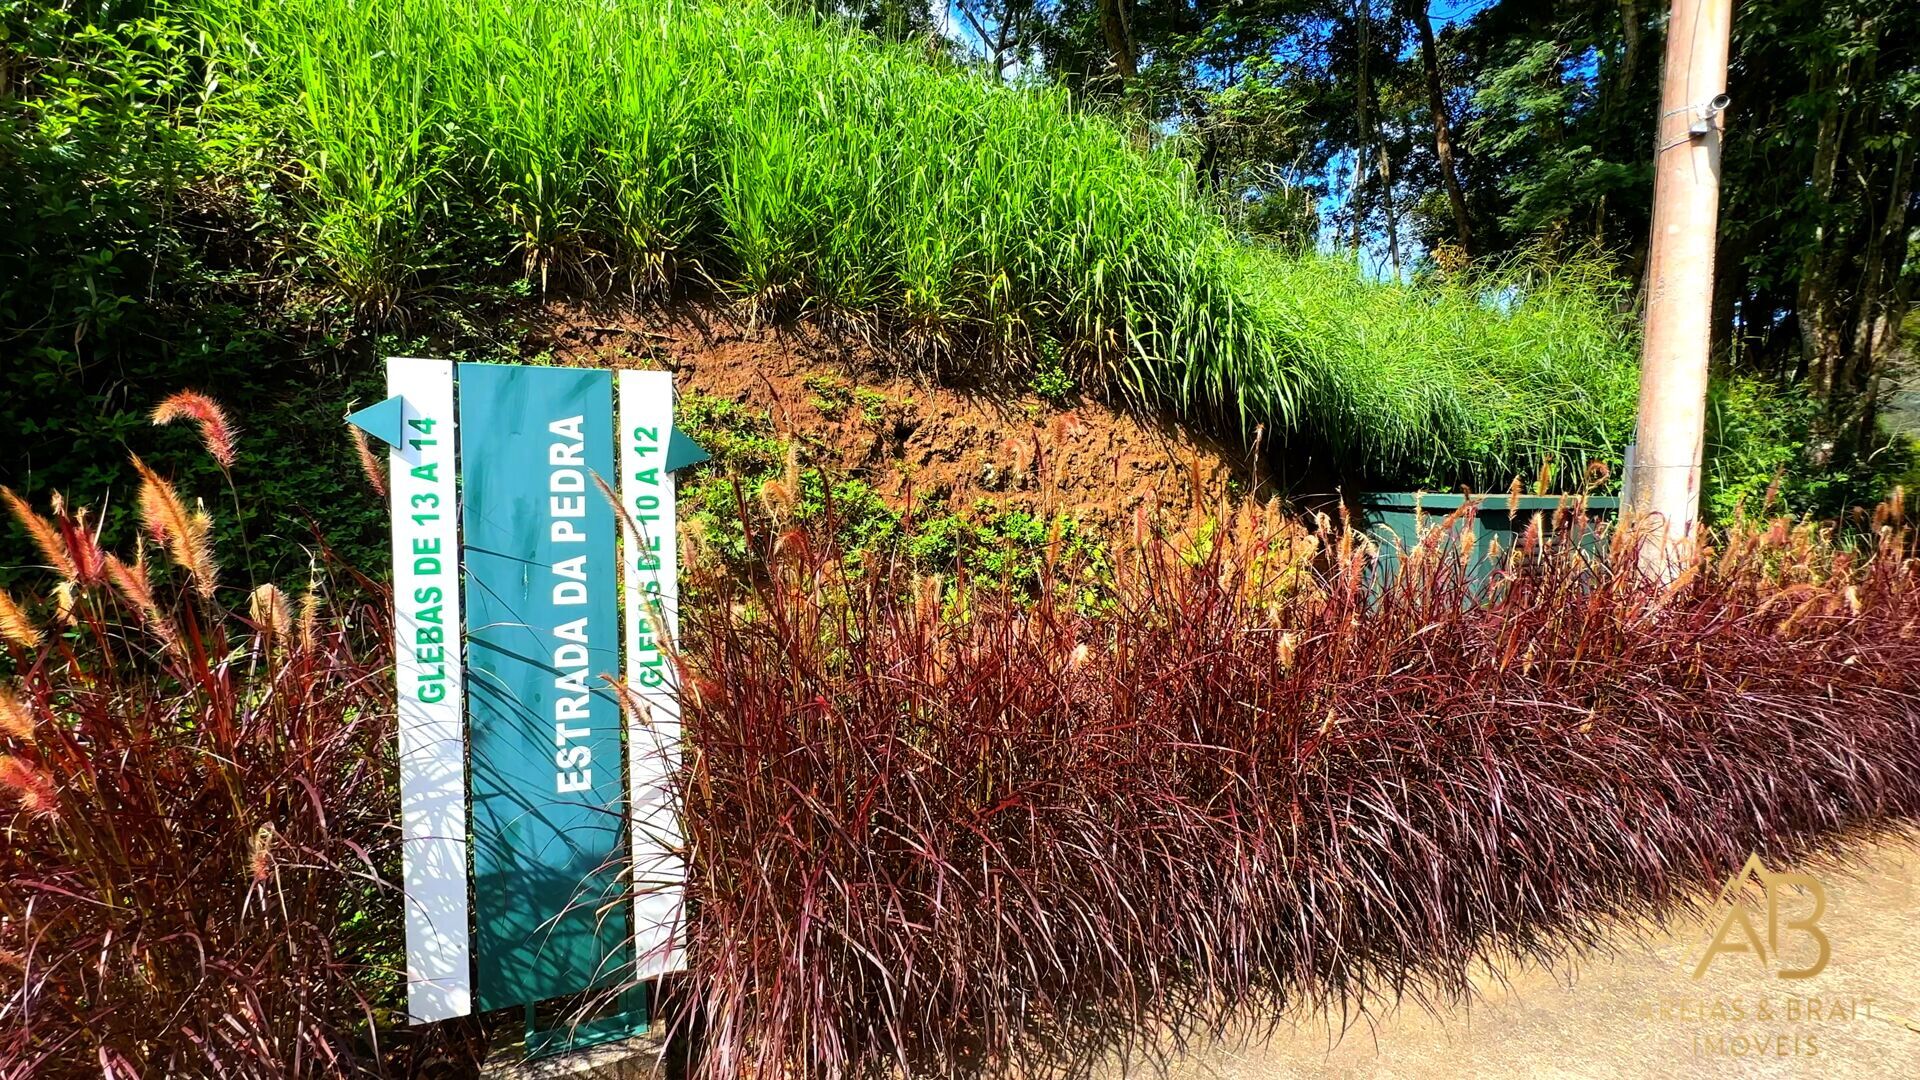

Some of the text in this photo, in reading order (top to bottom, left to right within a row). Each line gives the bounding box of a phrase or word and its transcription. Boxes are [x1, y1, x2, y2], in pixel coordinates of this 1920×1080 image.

[633, 426, 659, 458] 12
[635, 468, 660, 487] A
[635, 495, 660, 521] 10
[408, 417, 447, 704] GLEBAS DE 13 A 14
[637, 536, 661, 571] DE
[549, 415, 592, 793] ESTRADA DA PEDRA
